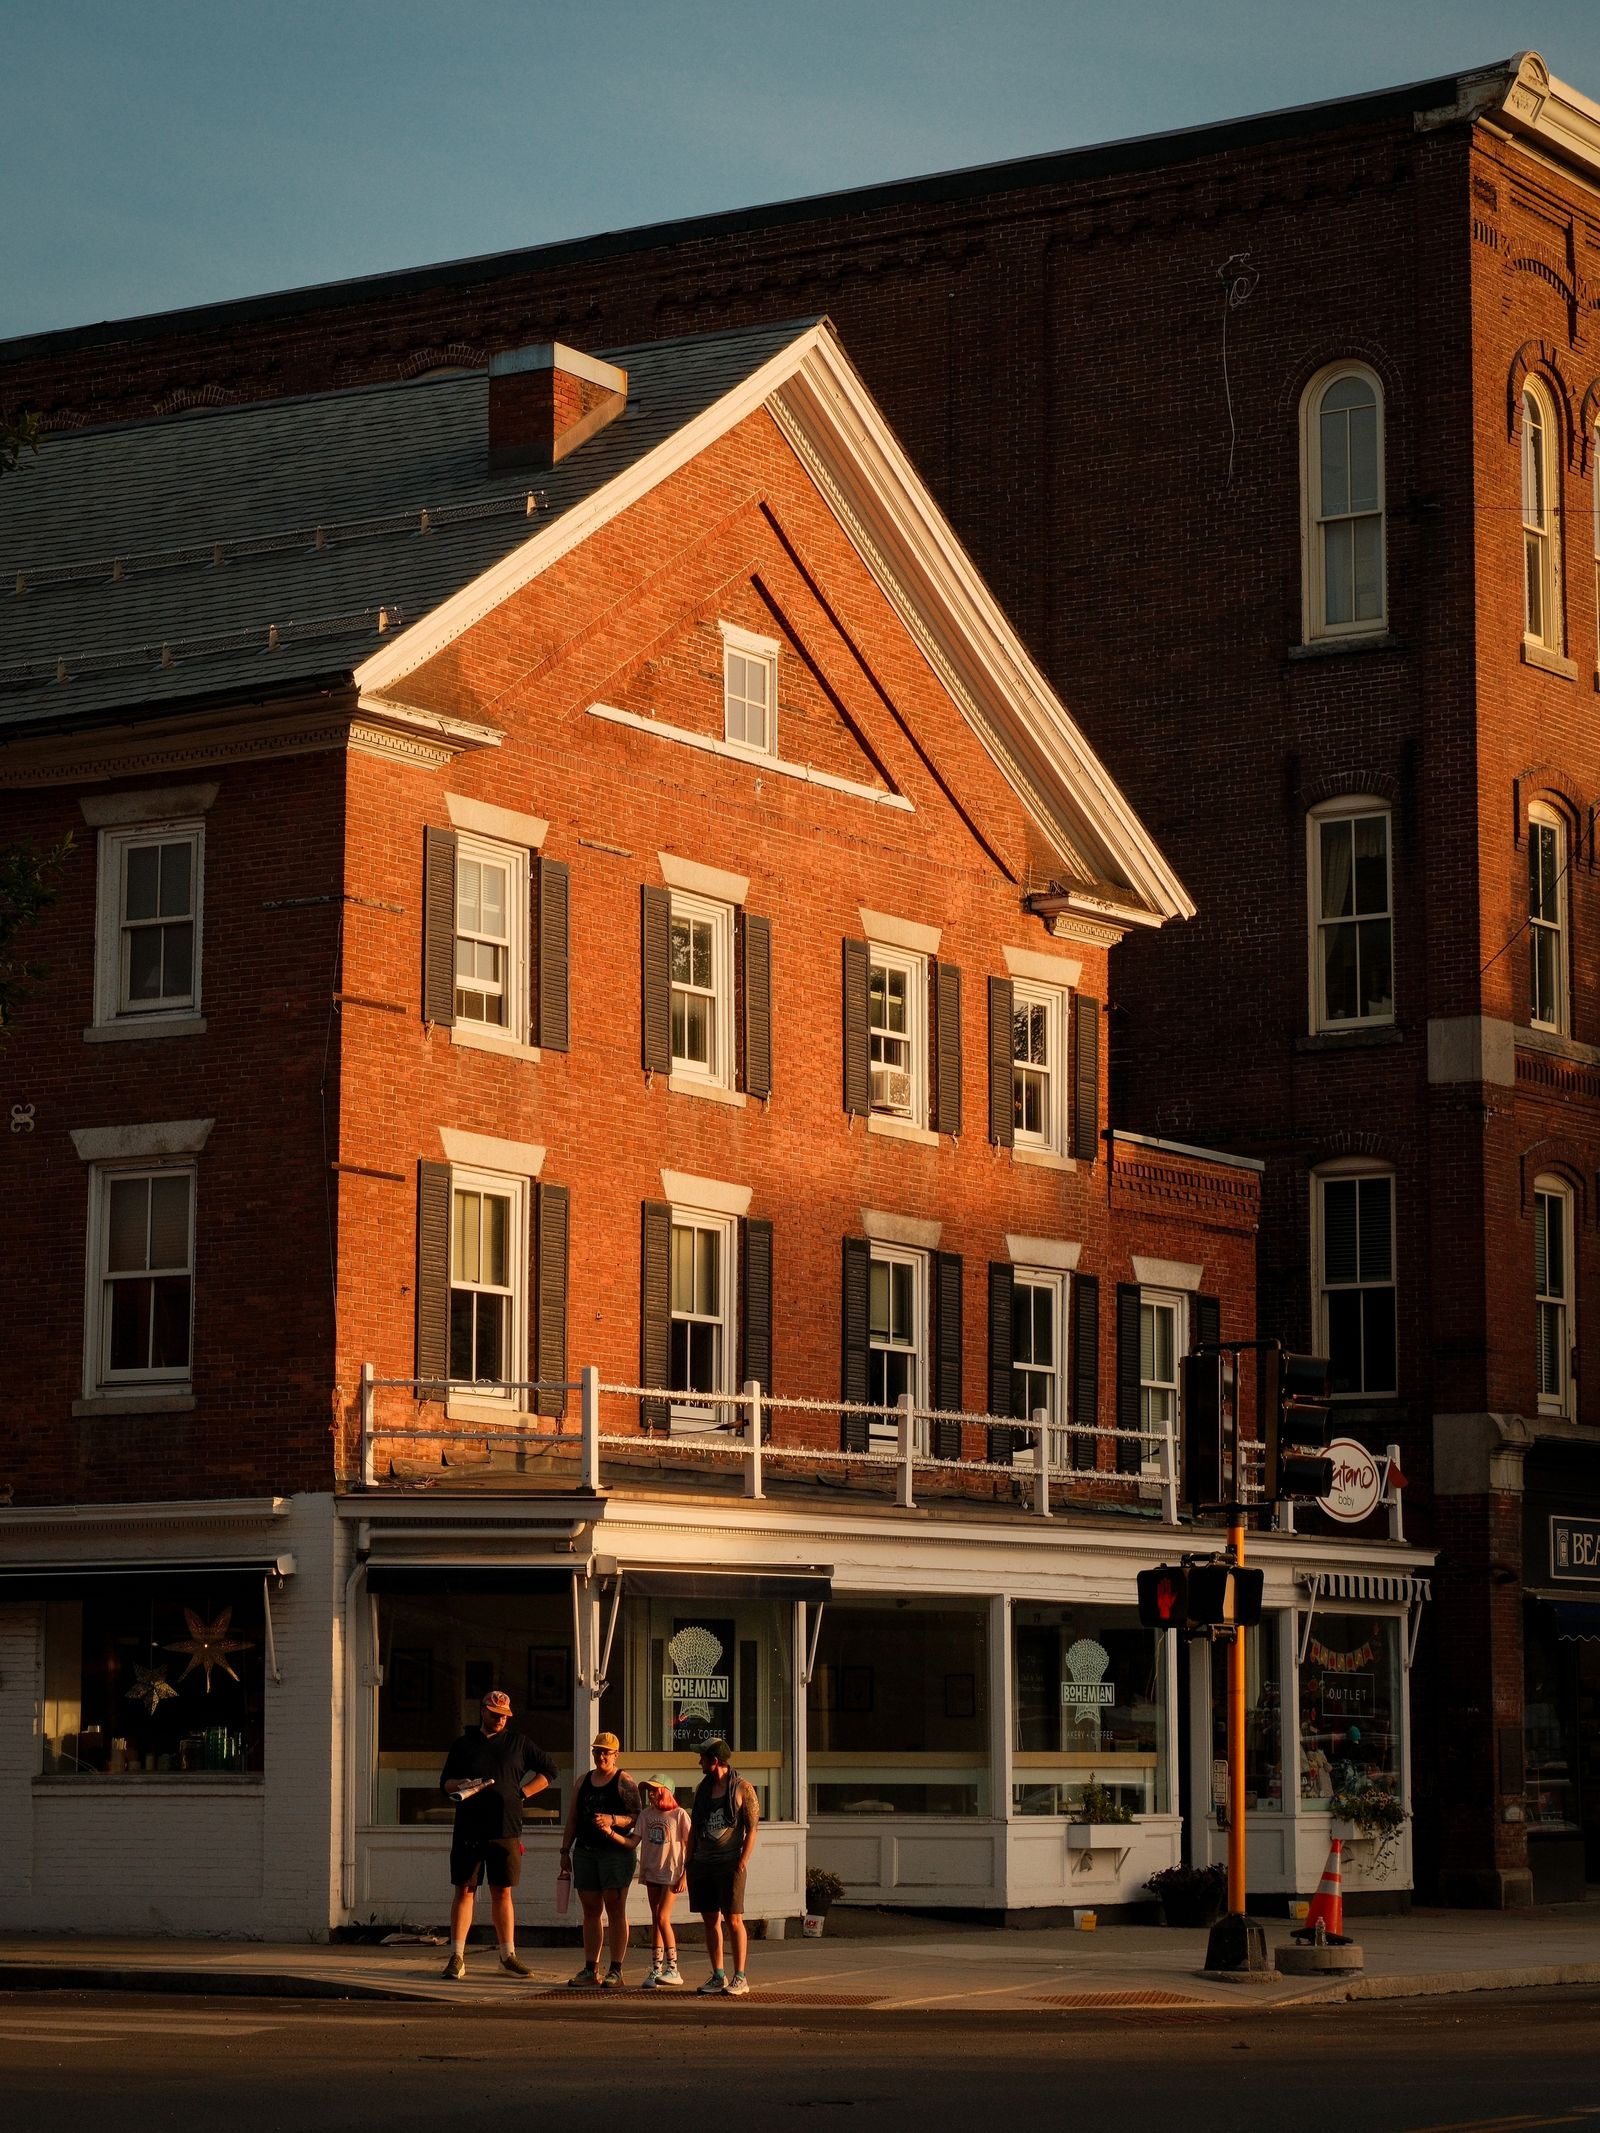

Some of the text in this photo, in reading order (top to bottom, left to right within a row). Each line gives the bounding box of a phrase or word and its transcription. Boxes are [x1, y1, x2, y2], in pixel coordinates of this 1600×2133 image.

[1338, 1494, 1355, 1509] baby
[665, 1679, 726, 1698] BOHEMIAN
[1063, 1685, 1113, 1703] BOHEMIAN
[1329, 1688, 1366, 1701] OUTLET
[1067, 1730, 1085, 1740] AKERY
